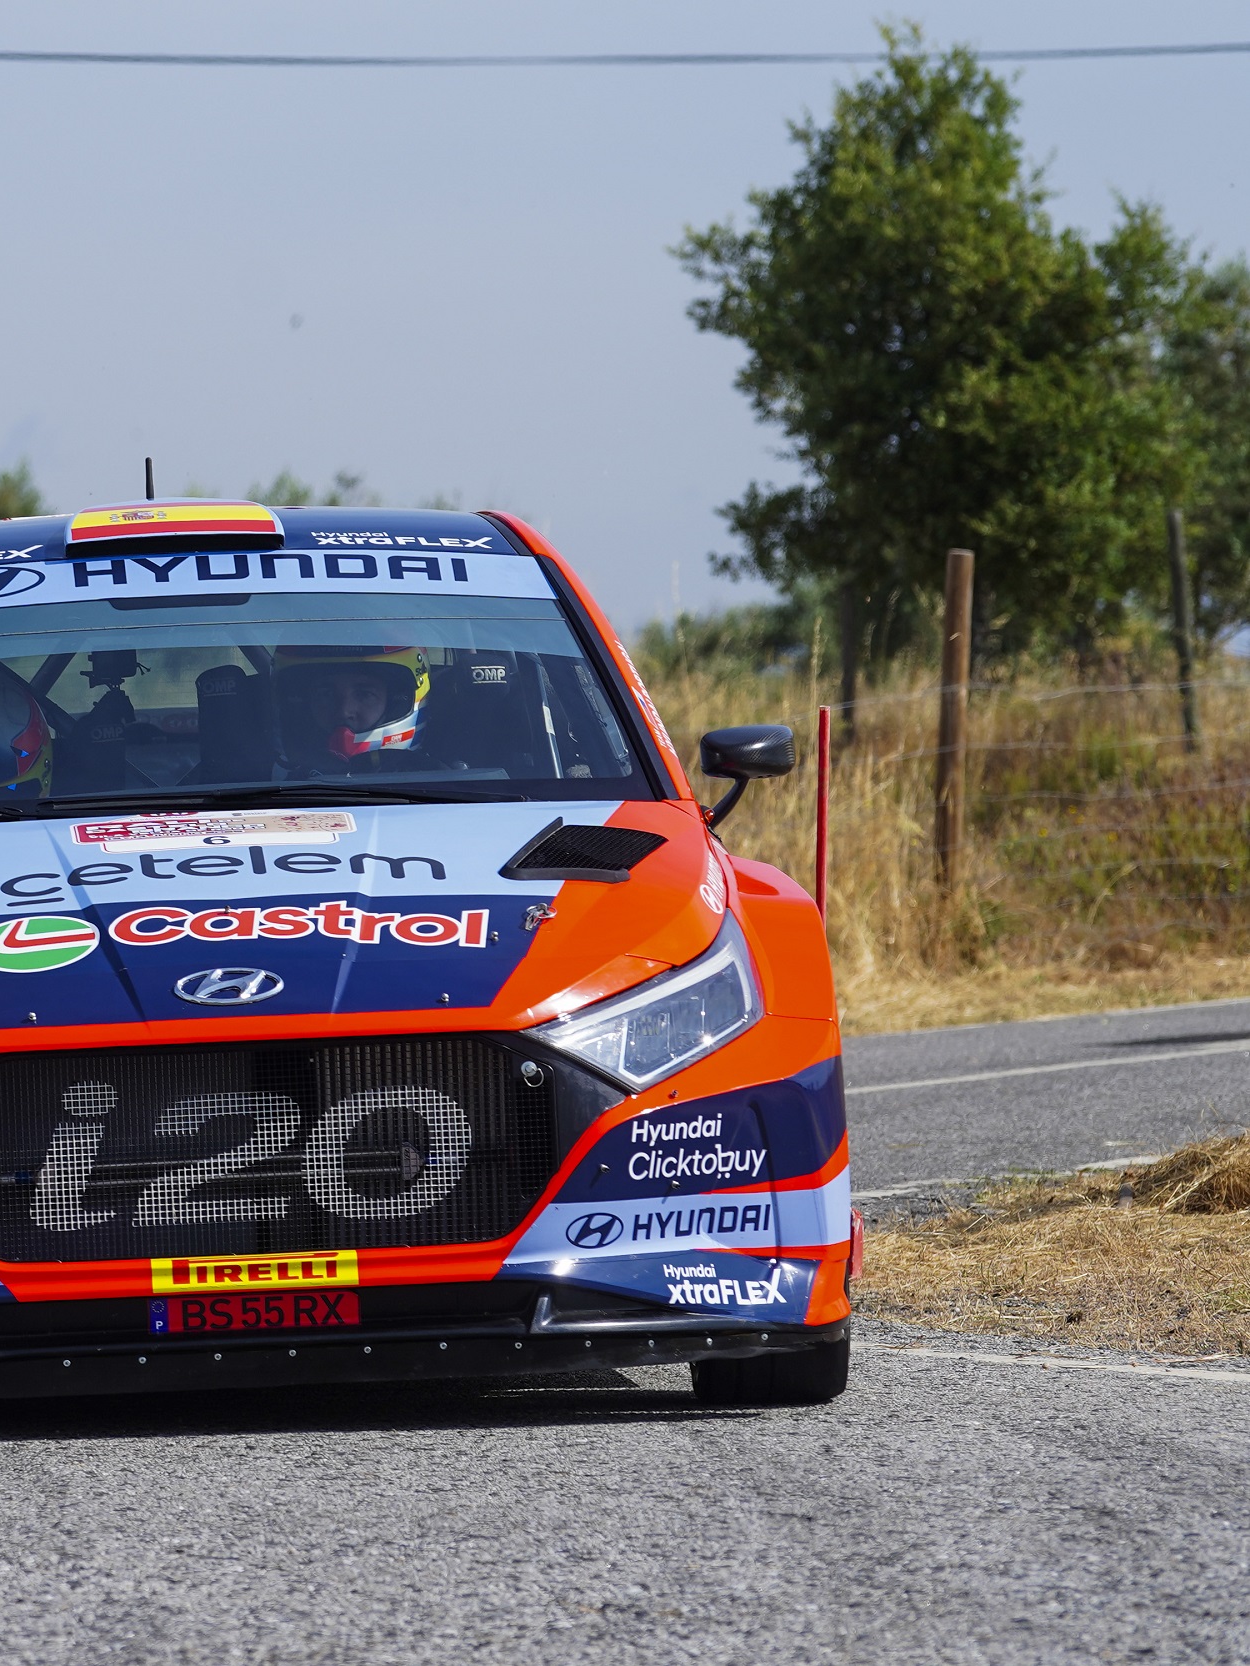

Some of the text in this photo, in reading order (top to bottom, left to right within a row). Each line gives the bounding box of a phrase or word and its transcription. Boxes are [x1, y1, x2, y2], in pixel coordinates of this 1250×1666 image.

[317, 536, 493, 550] xtraFLEX
[72, 553, 469, 588] HYUNDAI
[472, 668, 506, 681] OMP
[203, 835, 231, 845] 6
[0, 846, 447, 900] cetelem
[108, 901, 490, 948] Castrol
[631, 1114, 723, 1146] Hyundai
[29, 1081, 472, 1232] i20
[628, 1144, 767, 1179] Clicktobuy
[632, 1204, 771, 1241] HYUNDAI
[171, 1252, 340, 1285] PIRELLI
[663, 1264, 716, 1279] Hyundai
[669, 1268, 788, 1305] xtraFLEX
[155, 1320, 164, 1330] P
[182, 1293, 345, 1331] BS 55 RX
